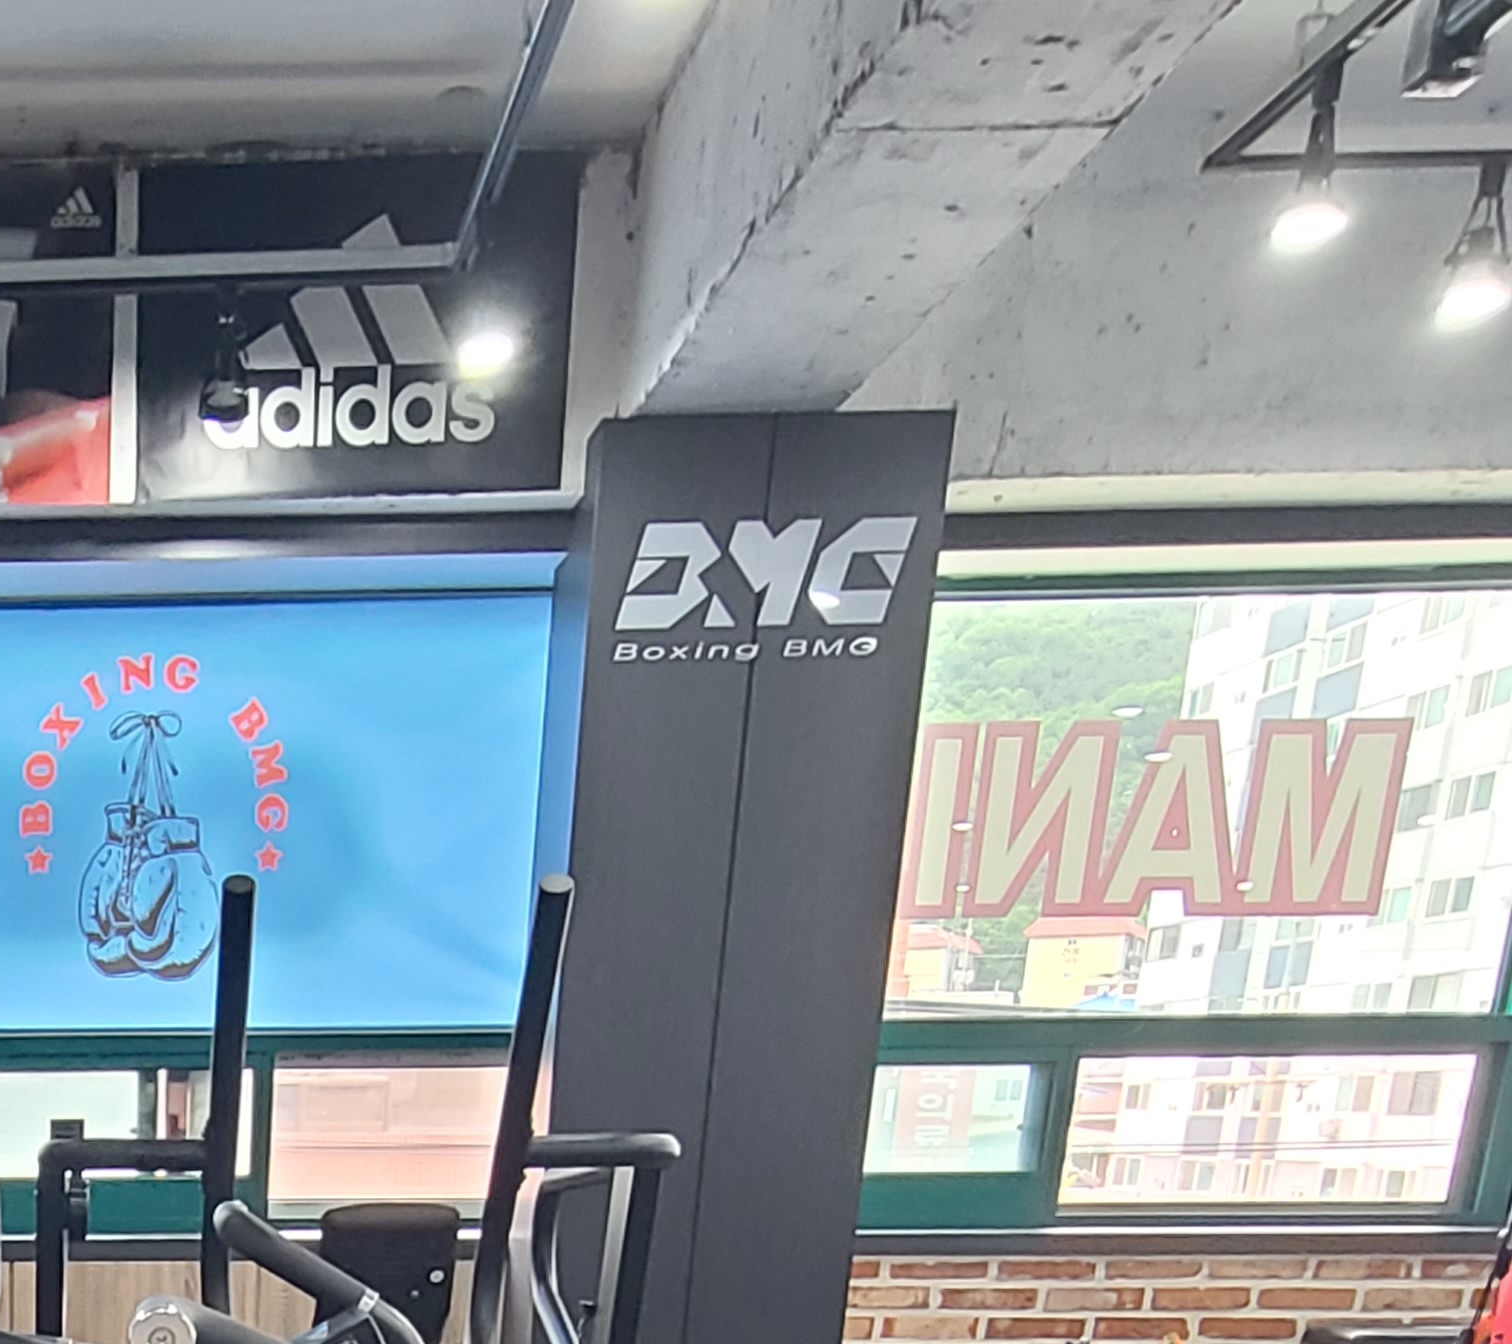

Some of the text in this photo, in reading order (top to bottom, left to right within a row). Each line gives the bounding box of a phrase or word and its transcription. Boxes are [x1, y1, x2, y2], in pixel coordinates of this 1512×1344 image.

[202, 363, 495, 449] adidas
[612, 637, 878, 662] Boxing BMG
[19, 654, 288, 837] BOXING BMG
